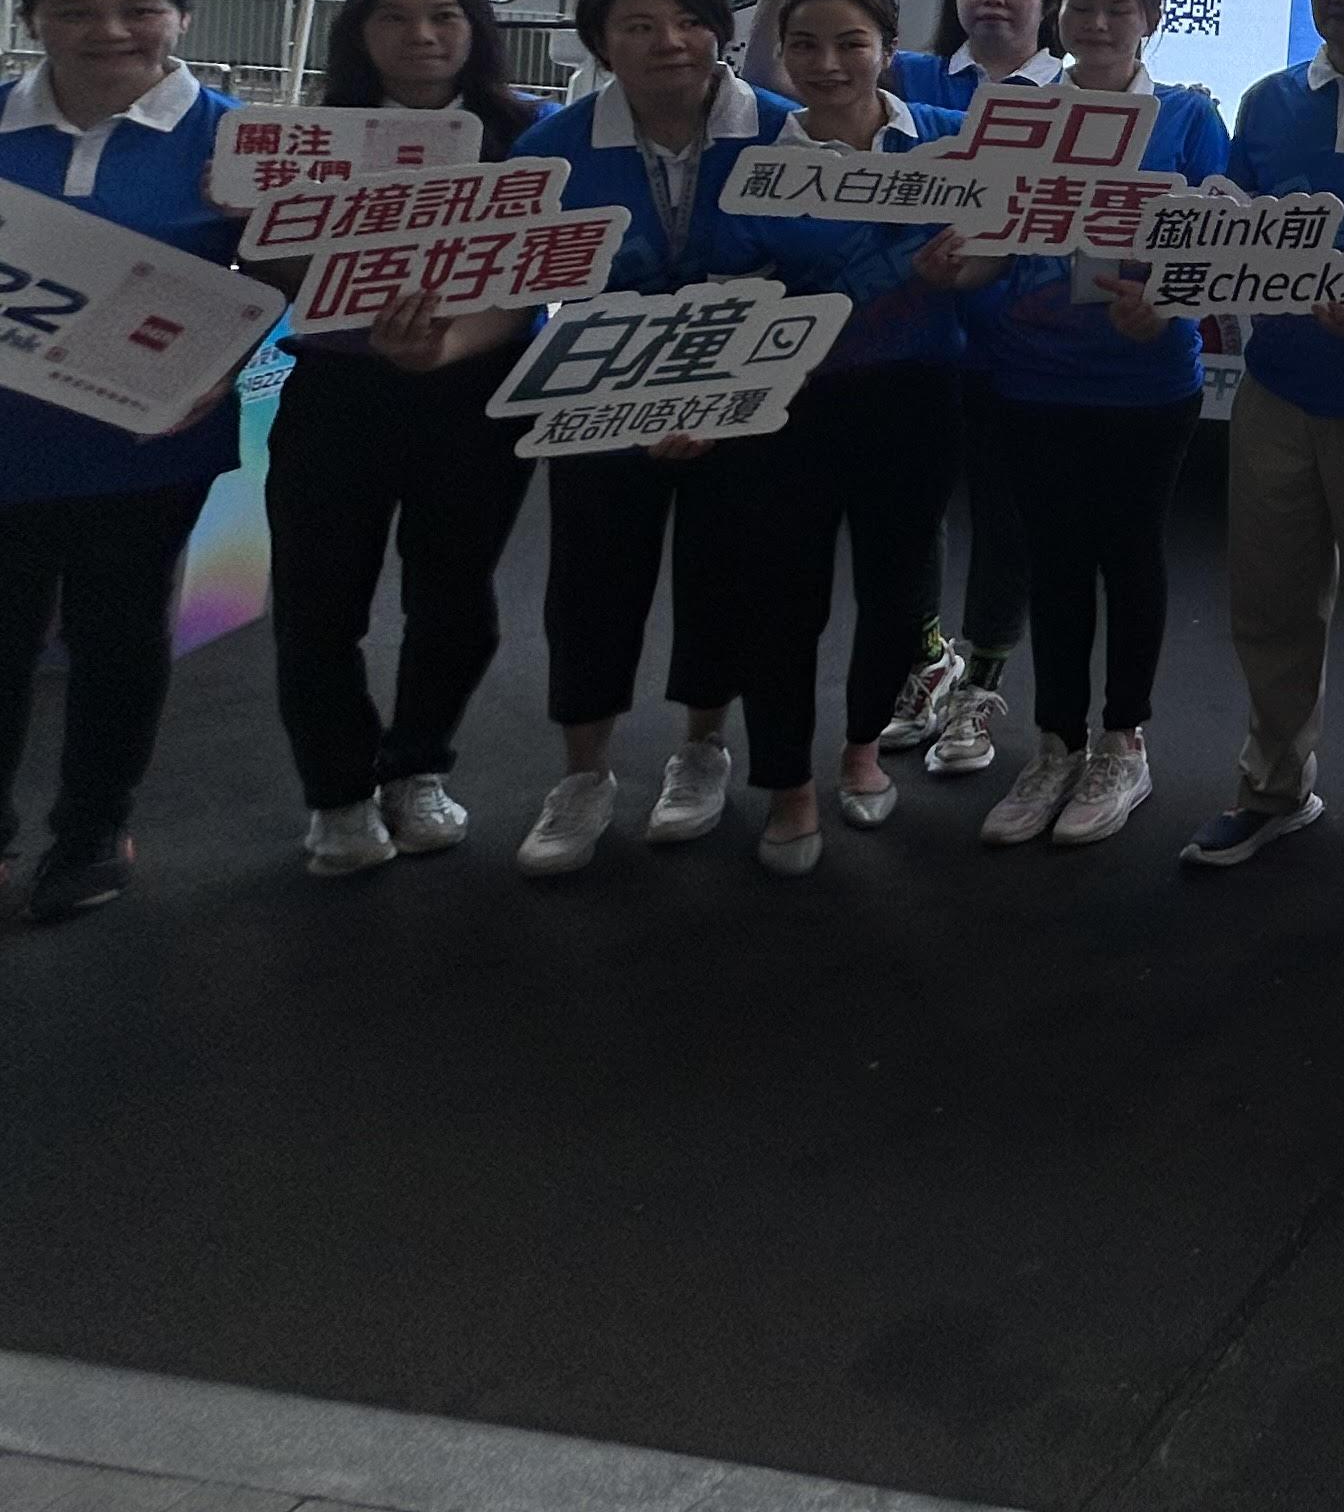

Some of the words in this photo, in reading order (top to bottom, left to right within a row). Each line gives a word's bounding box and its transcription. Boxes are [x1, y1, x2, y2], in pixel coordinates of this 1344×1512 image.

[256, 169, 552, 248] 白撞訊息
[306, 218, 612, 322] 唔好覆
[506, 298, 757, 403] 白撞
[534, 386, 773, 445] 短訊唔好覆
